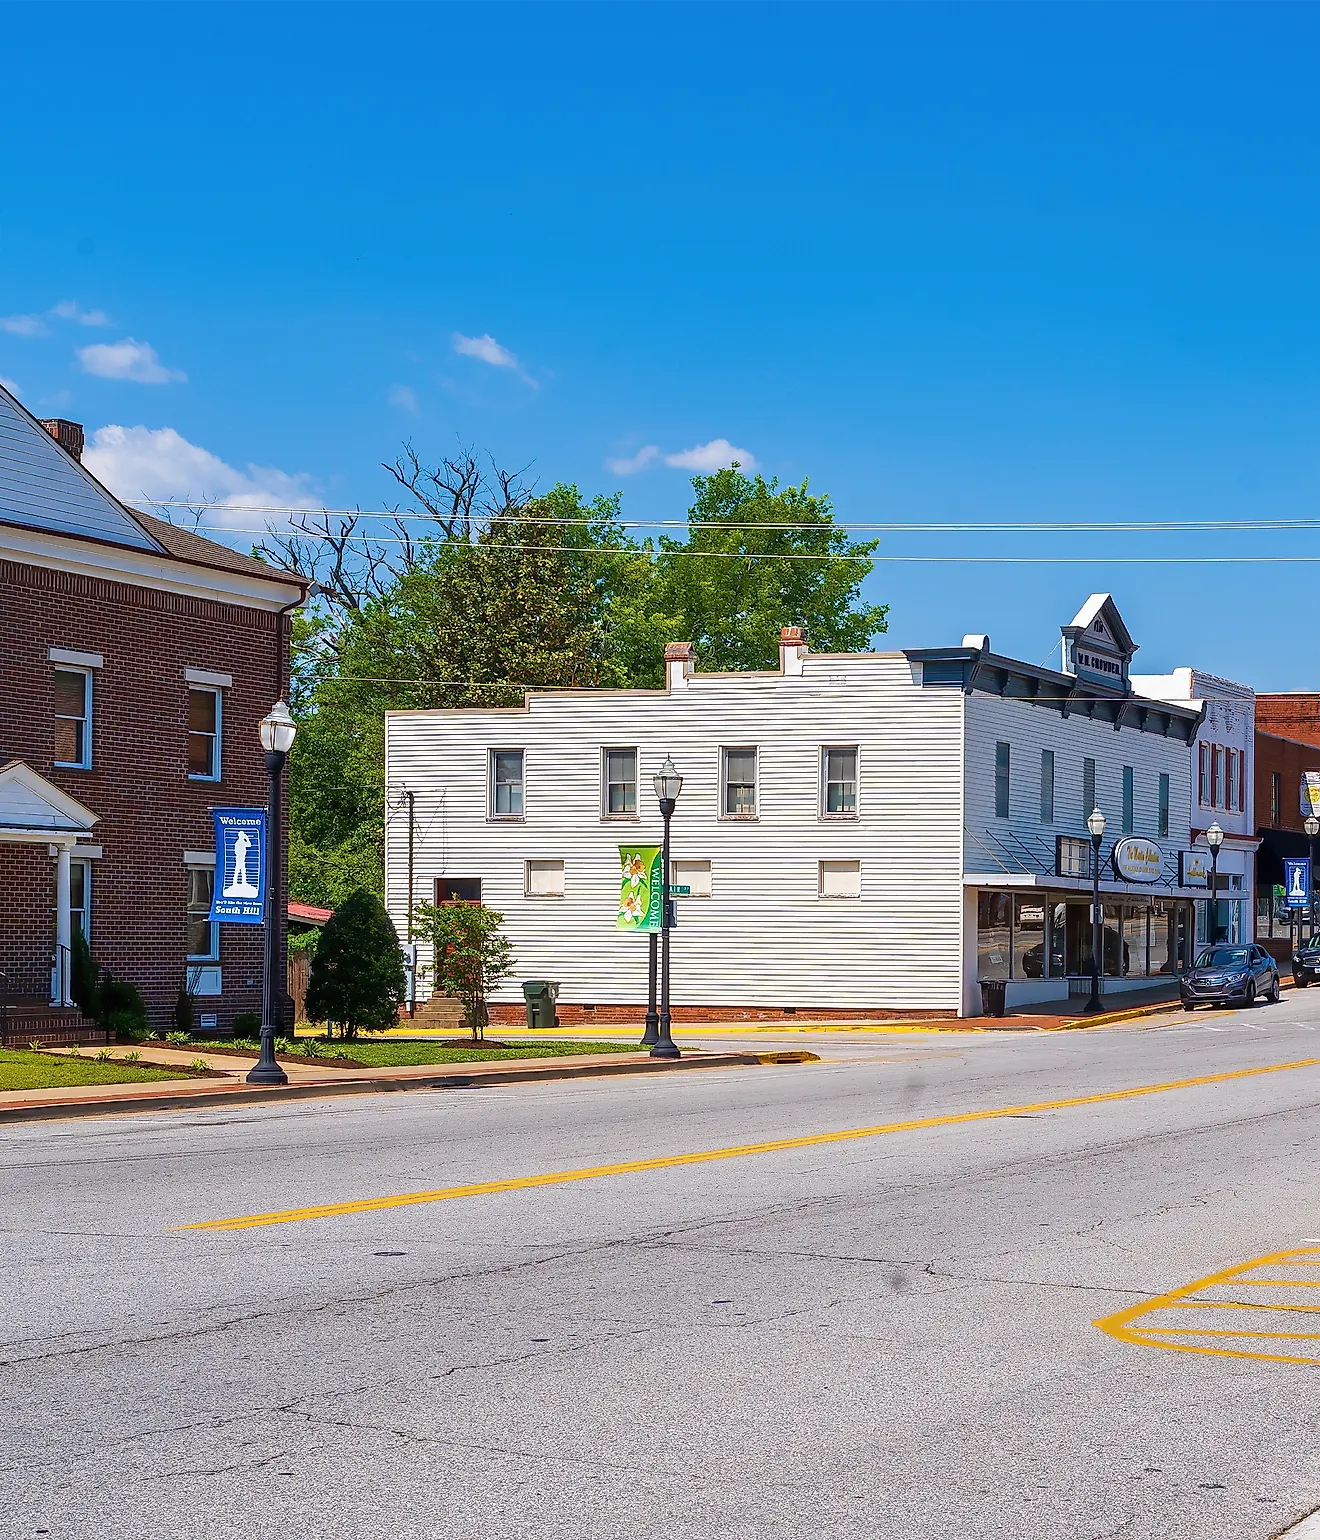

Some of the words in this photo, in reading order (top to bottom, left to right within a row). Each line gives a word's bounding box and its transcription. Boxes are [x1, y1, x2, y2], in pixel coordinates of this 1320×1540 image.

[219, 817, 261, 825] Welcome
[650, 868, 660, 926] WELCOME
[215, 905, 240, 914] South
[242, 906, 260, 915] Hill
